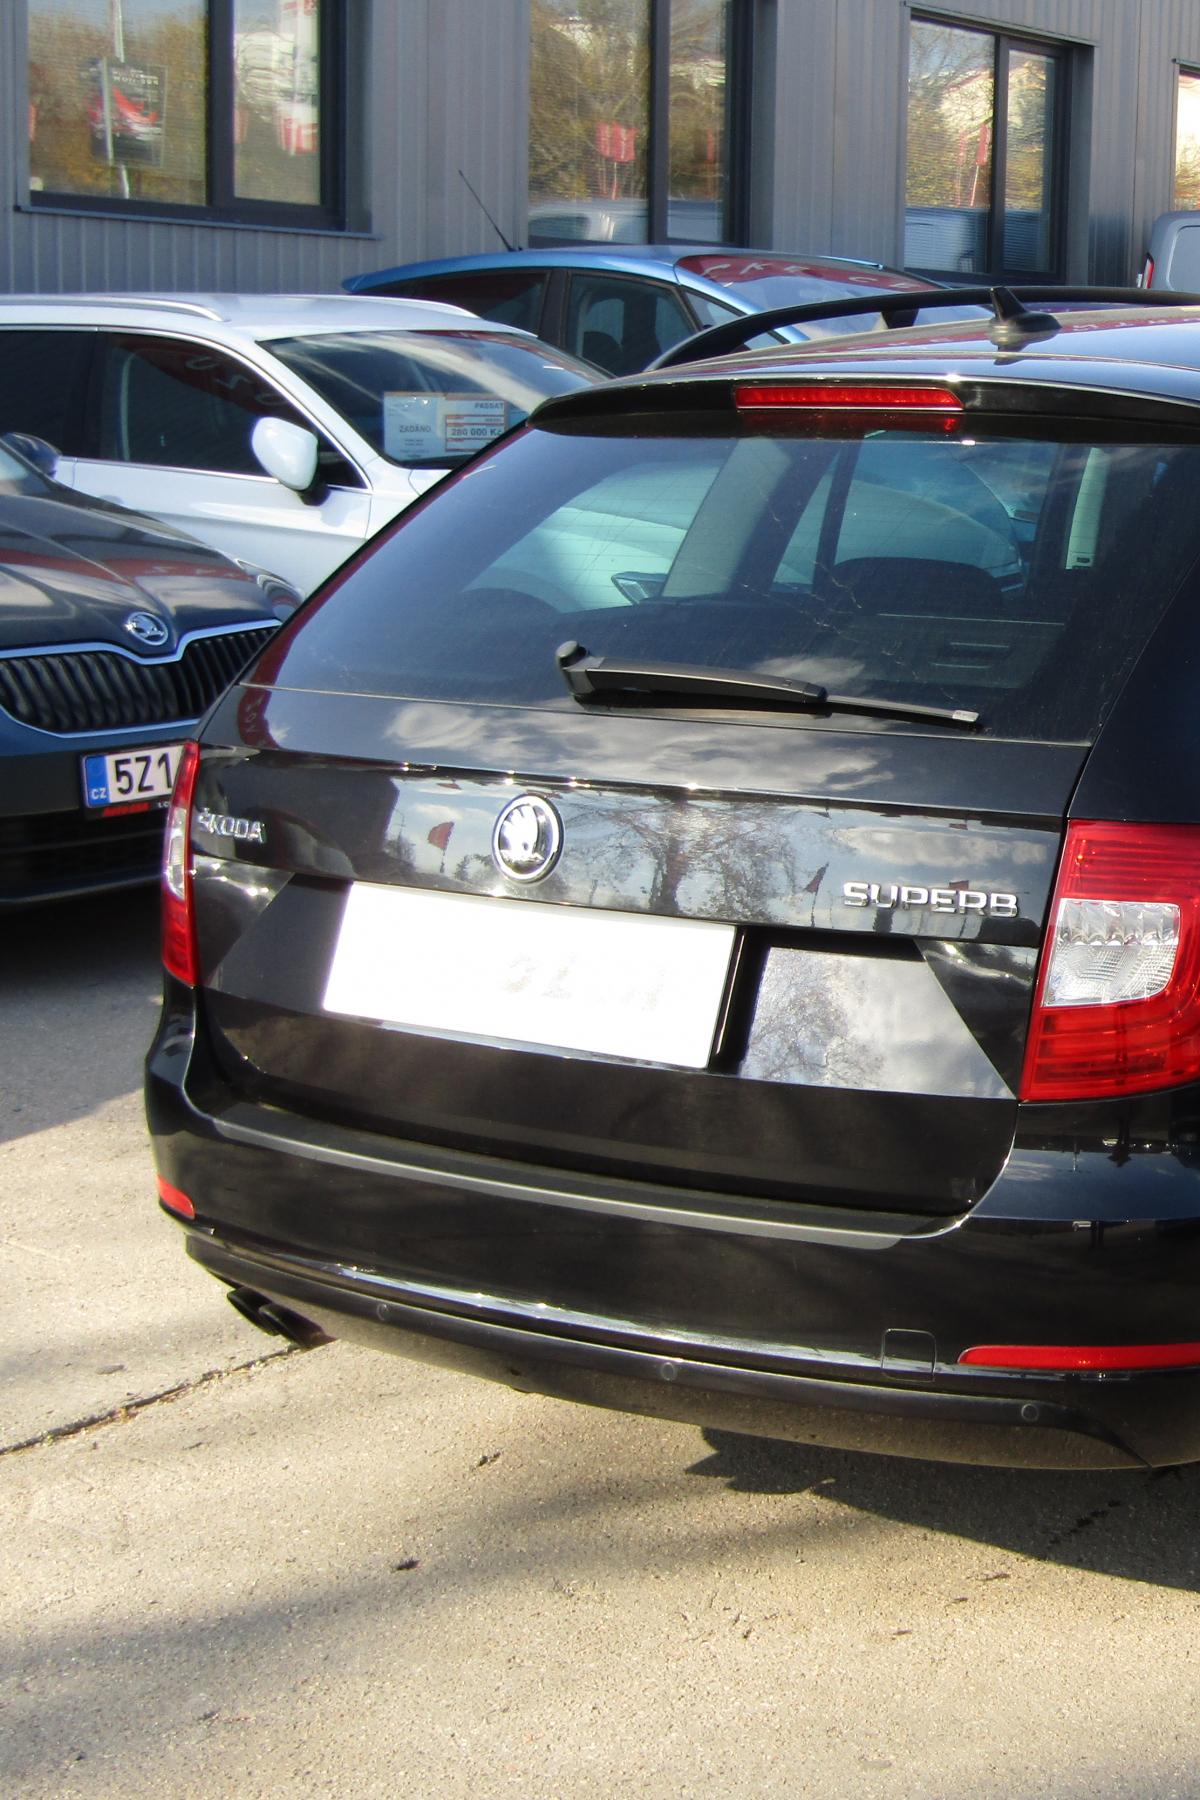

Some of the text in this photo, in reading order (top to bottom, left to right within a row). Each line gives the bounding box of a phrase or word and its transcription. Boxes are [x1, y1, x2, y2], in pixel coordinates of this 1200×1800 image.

[470, 428, 487, 436] 000
[114, 752, 172, 795] 5Z1
[91, 787, 107, 799] CZ
[198, 807, 264, 844] ŠKODA
[843, 881, 1018, 918] SUPERB
